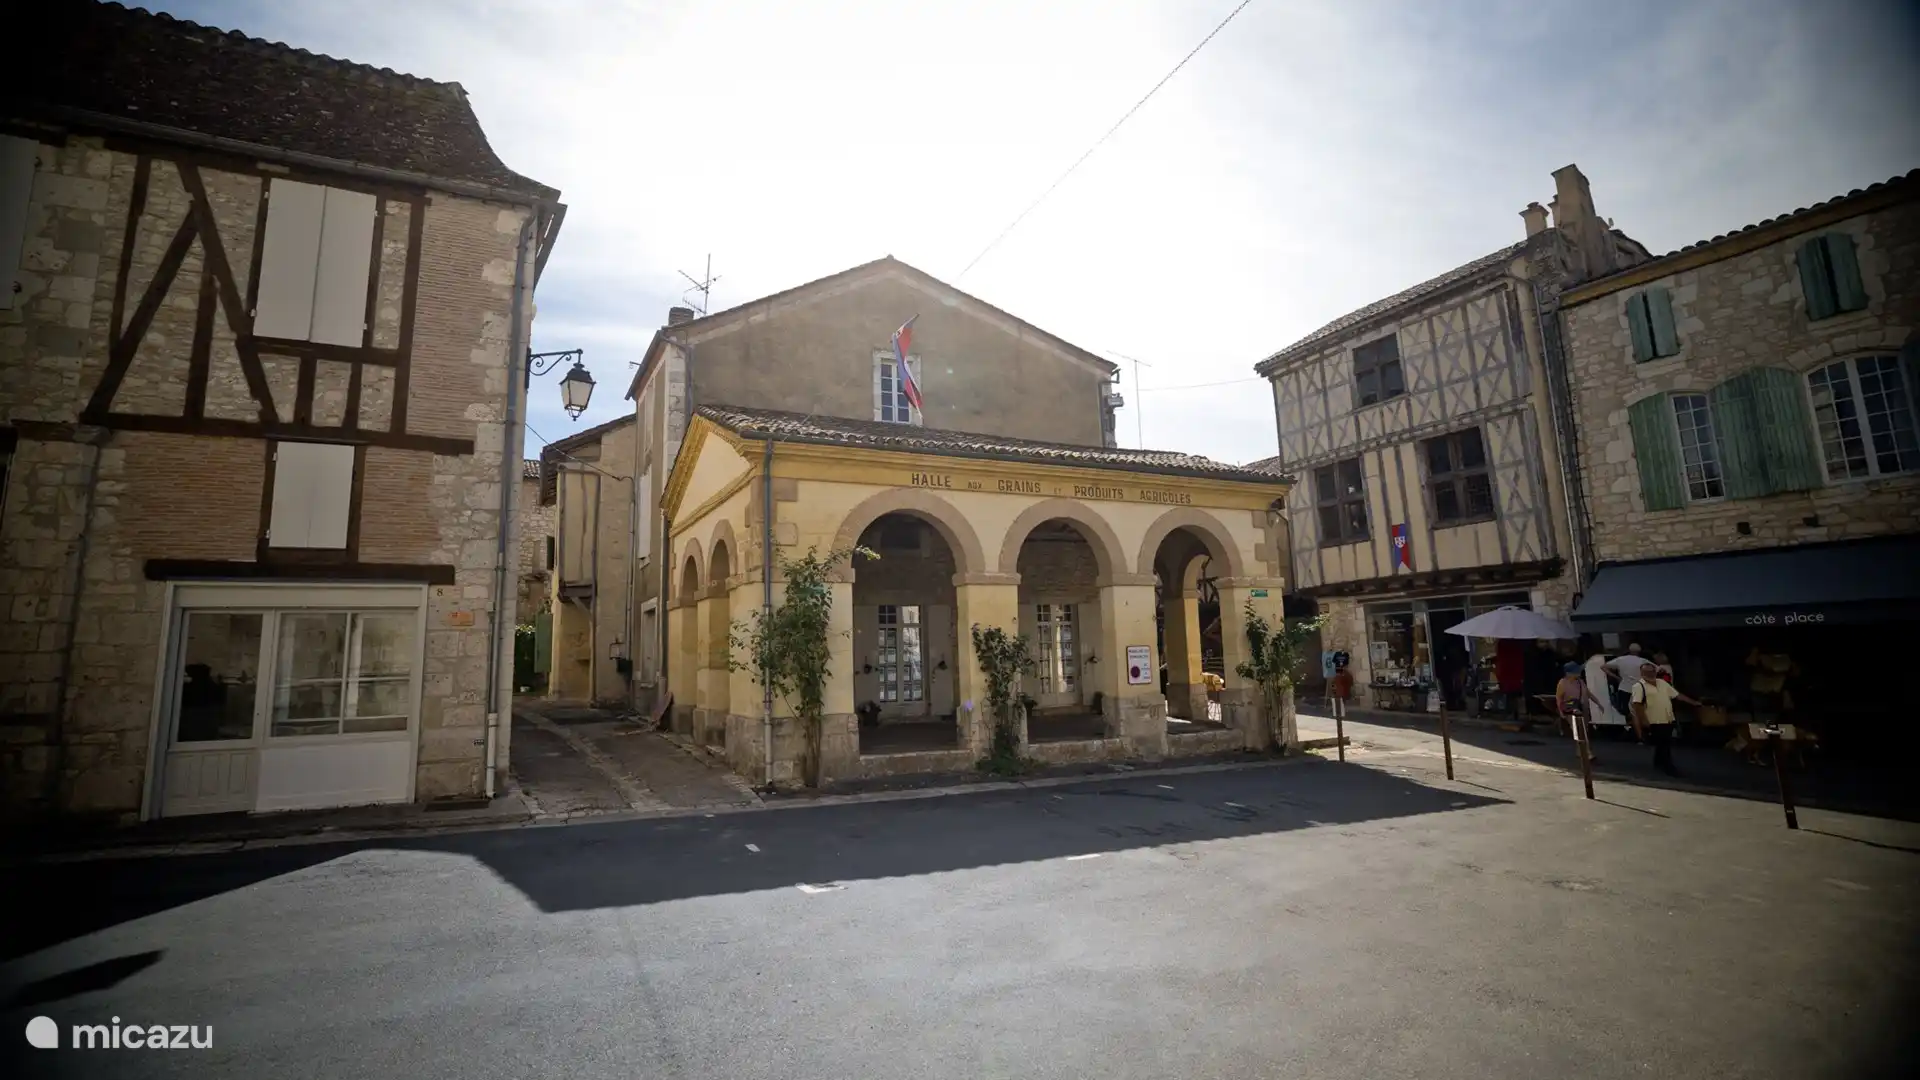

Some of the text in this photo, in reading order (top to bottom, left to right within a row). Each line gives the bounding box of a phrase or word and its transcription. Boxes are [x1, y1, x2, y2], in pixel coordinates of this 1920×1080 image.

[911, 473, 952, 487] HALLE
[967, 481, 982, 490] AUX
[997, 479, 1041, 493] GRAINS
[1073, 485, 1124, 499] PRODUITS
[1140, 489, 1192, 504] AGRICOLES
[436, 587, 444, 597] 8
